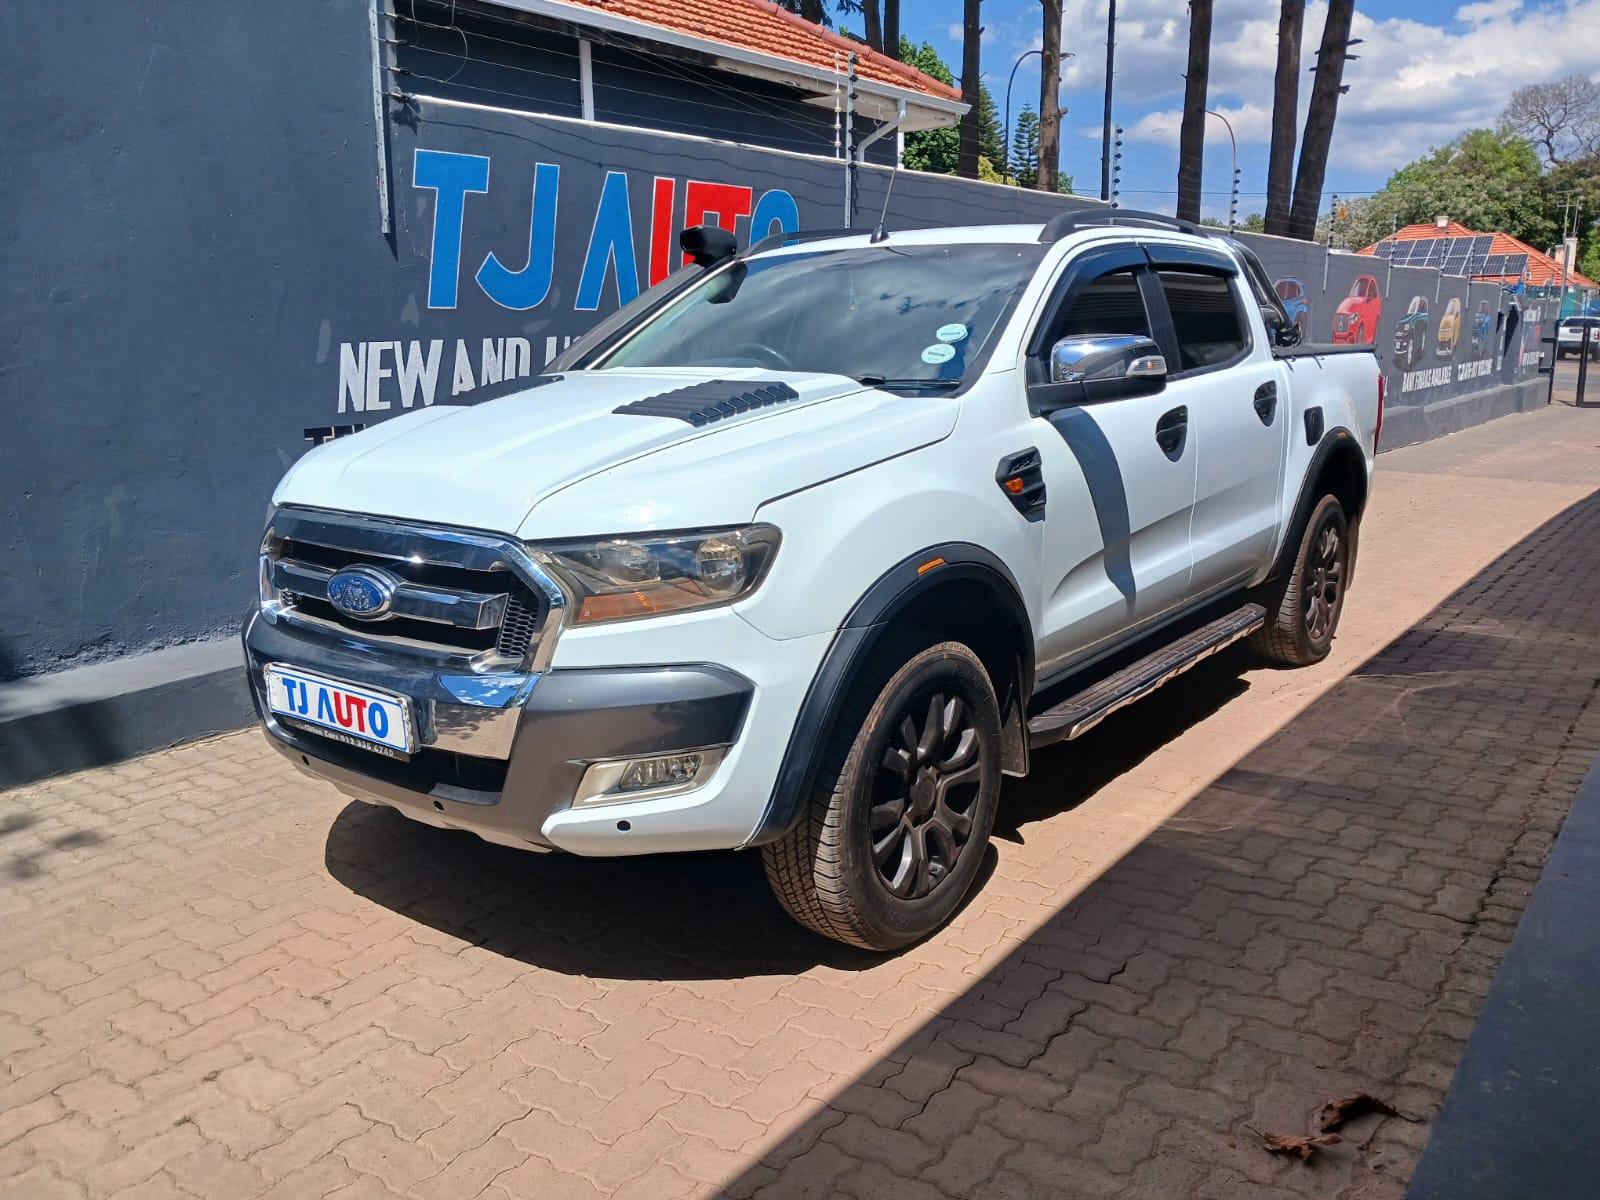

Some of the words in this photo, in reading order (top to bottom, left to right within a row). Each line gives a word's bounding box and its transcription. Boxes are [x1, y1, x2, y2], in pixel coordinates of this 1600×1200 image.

[412, 148, 561, 310] TJ
[337, 339, 444, 413] NEW
[452, 337, 531, 396] AND
[282, 677, 308, 715] TJ
[317, 686, 389, 739] AUTO
